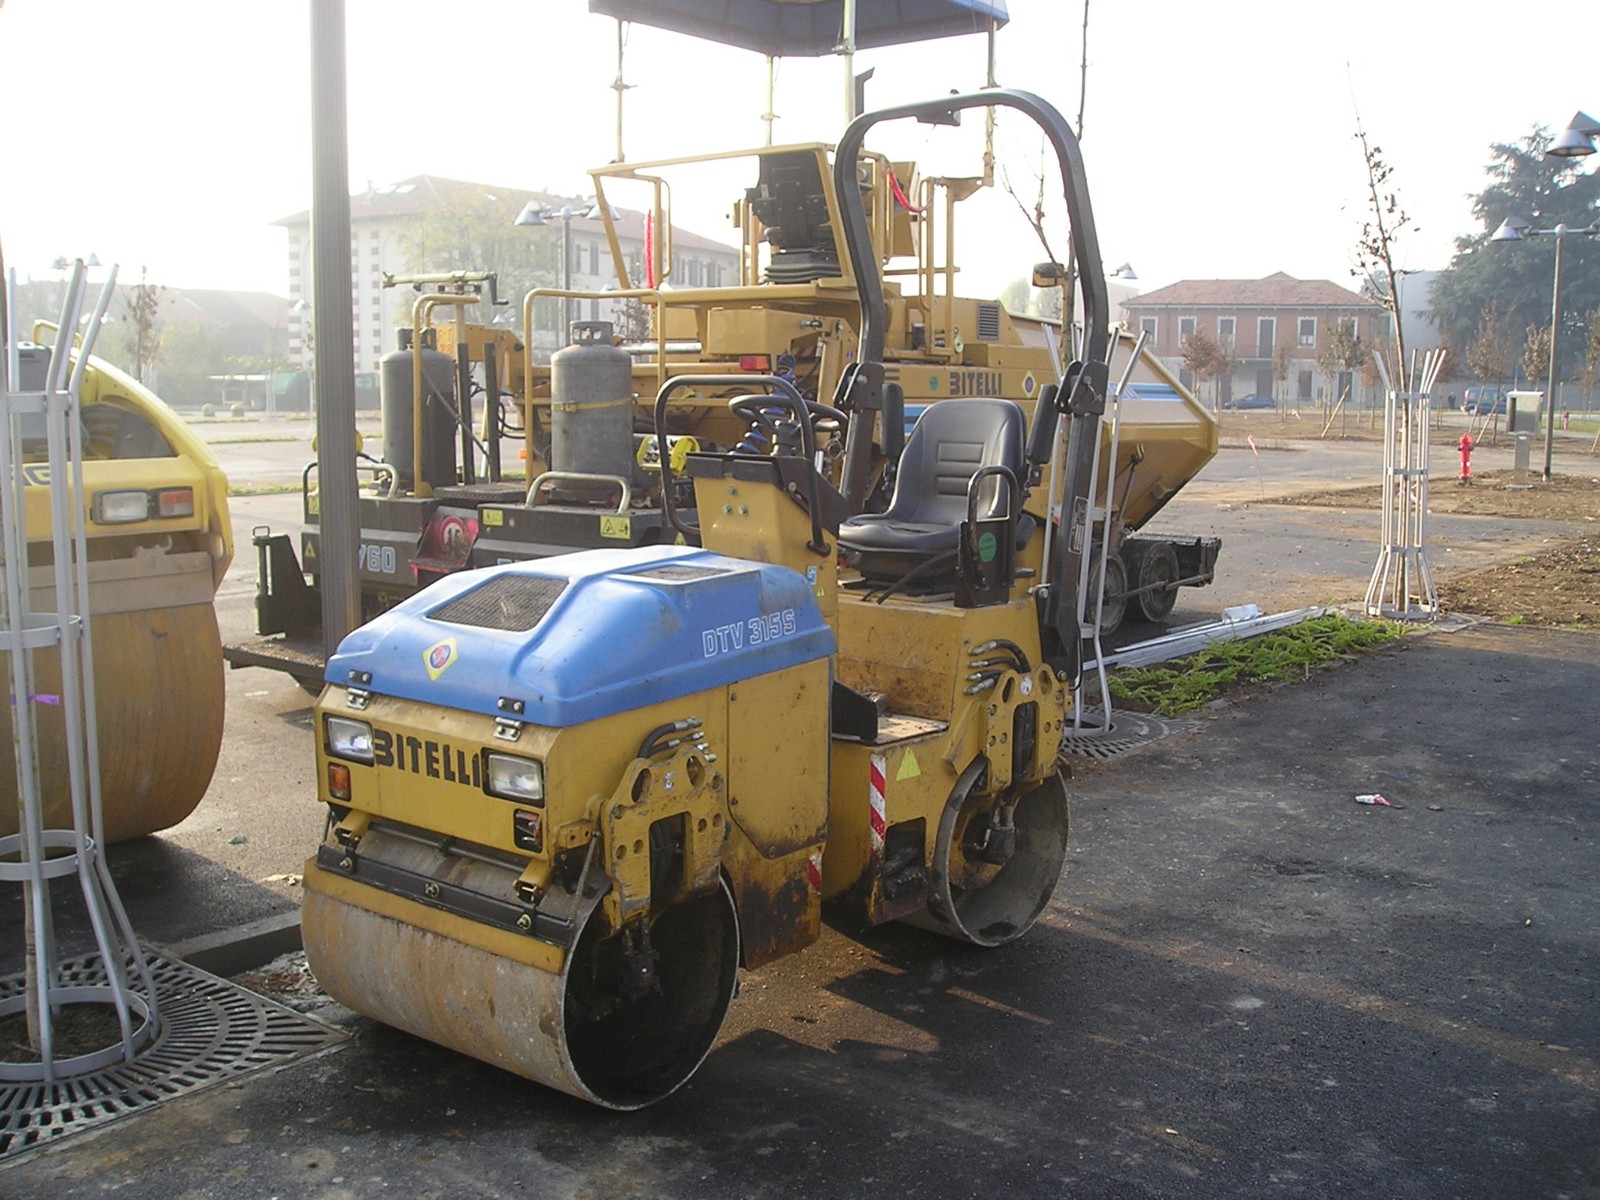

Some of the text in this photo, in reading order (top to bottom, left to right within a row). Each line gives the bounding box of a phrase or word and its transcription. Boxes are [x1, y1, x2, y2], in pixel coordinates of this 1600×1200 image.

[949, 372, 1002, 396] BITELLI
[702, 608, 797, 658] DTV 315S
[374, 728, 481, 788] BITELLI
